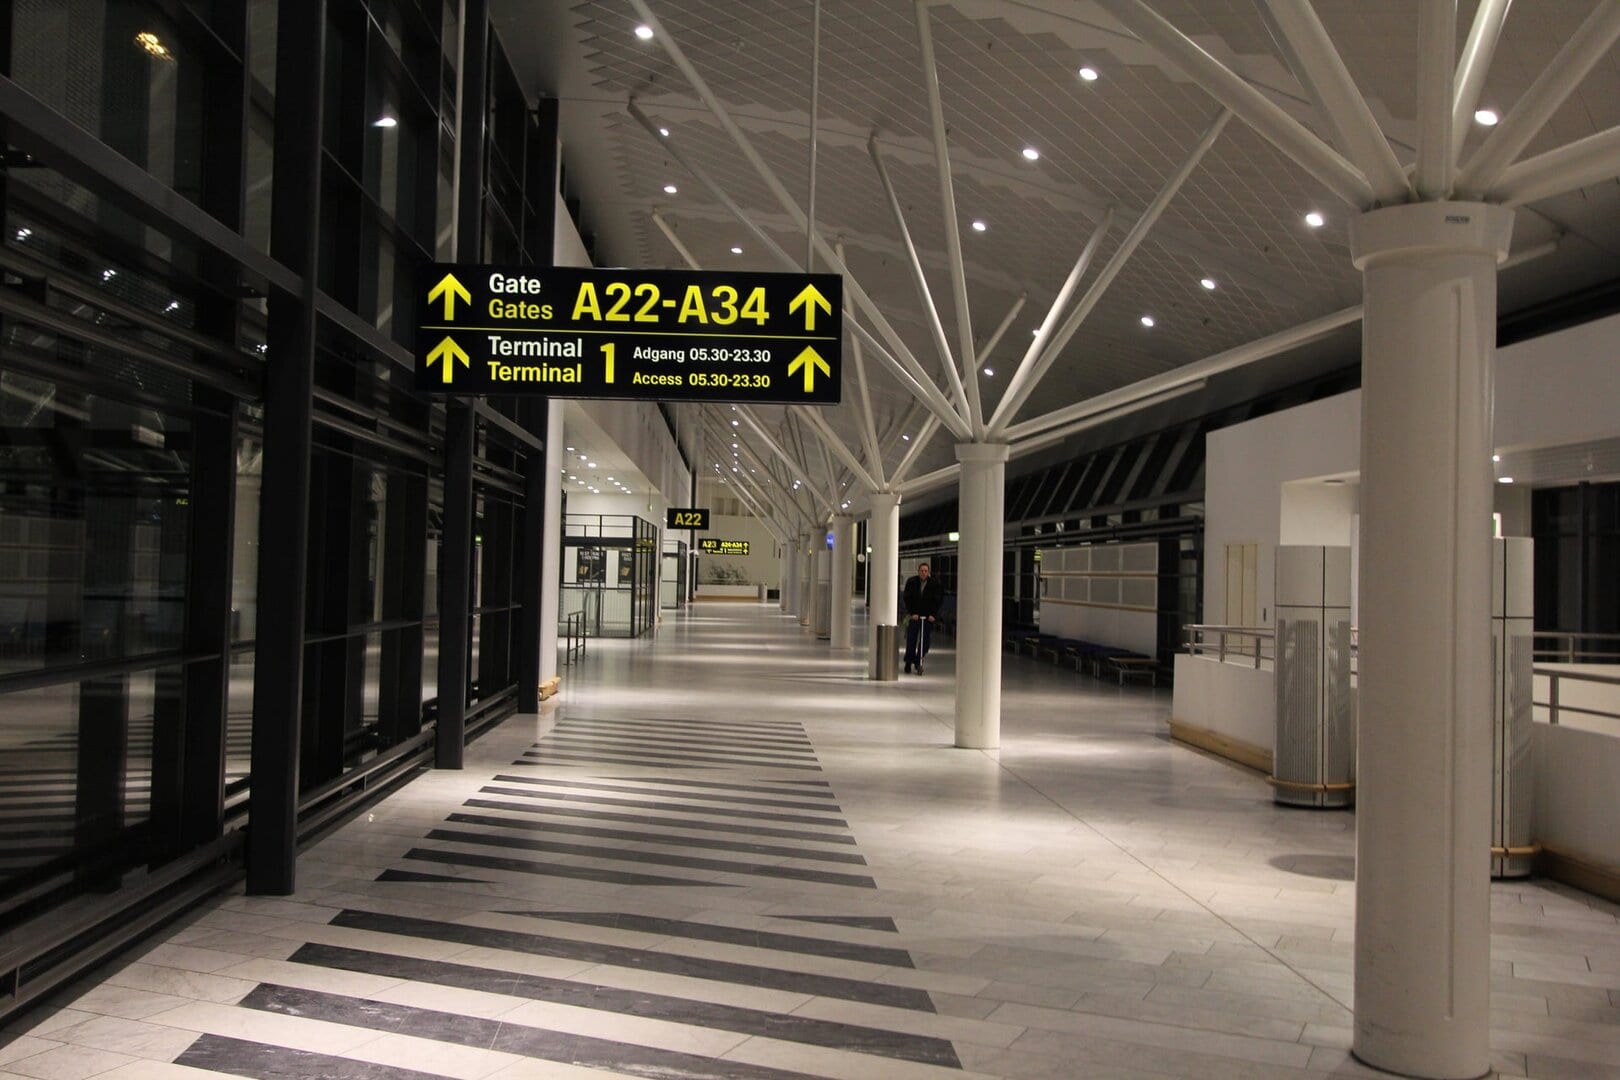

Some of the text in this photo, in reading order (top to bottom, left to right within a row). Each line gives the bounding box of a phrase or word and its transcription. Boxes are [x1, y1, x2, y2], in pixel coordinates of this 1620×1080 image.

[489, 273, 541, 294] Gate
[488, 298, 553, 320] Gates
[571, 282, 770, 326] A22-A34
[488, 335, 583, 358] Terminal
[633, 346, 771, 363] Adgang 05.30-23.30
[487, 361, 582, 383] Terminal
[600, 342, 615, 384] 1
[632, 371, 771, 388] Access 05.30-23.30
[674, 512, 702, 526] A22
